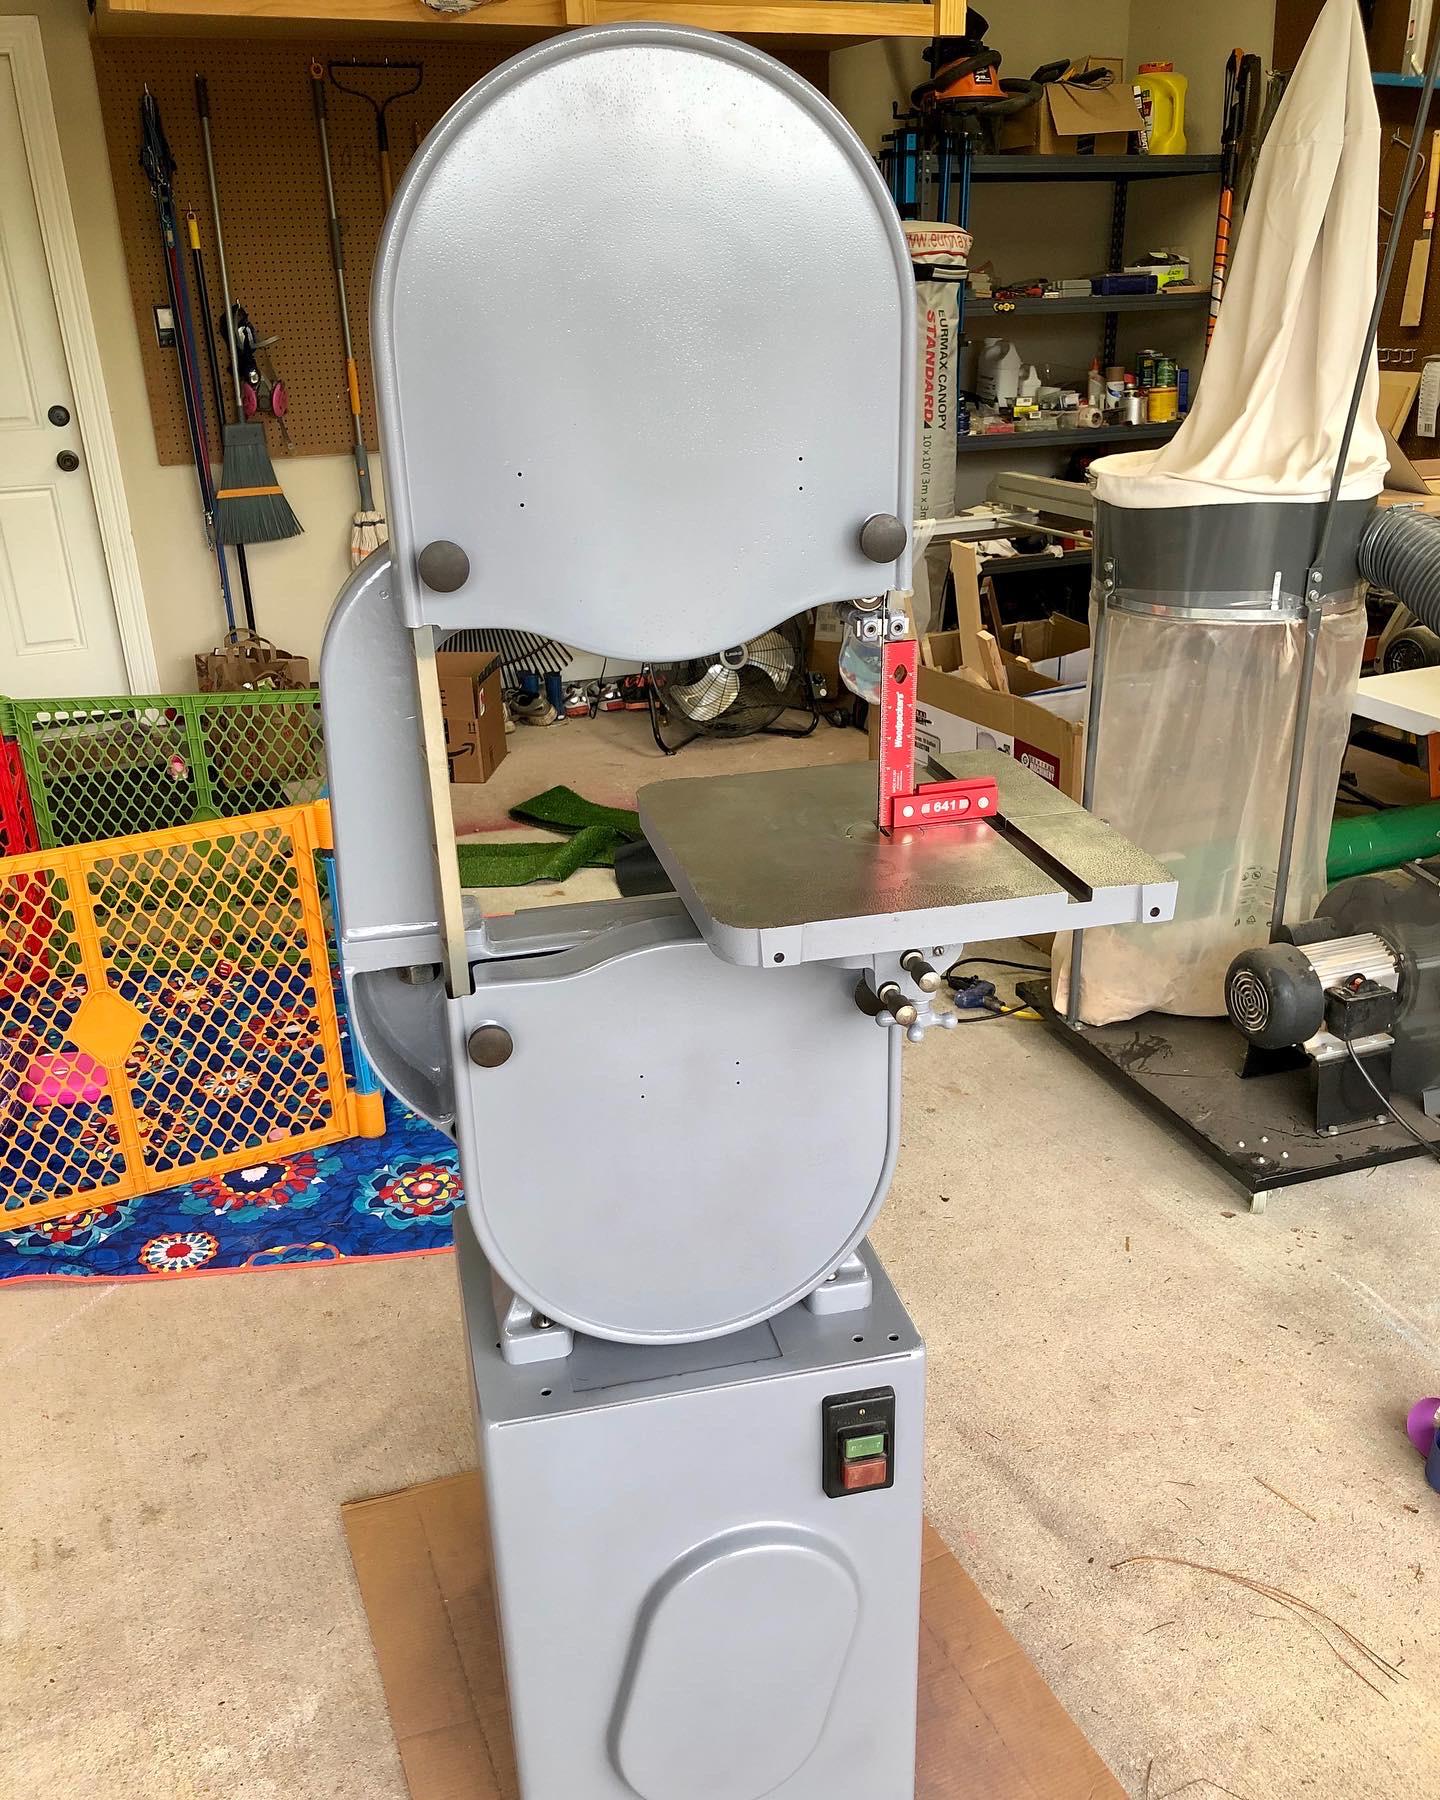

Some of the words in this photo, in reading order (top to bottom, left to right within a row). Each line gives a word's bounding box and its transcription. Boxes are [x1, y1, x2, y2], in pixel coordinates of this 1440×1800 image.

[923, 309, 937, 423] STANDARD
[938, 309, 949, 371] EURMAX
[937, 373, 948, 431] CANOPY
[894, 691, 905, 748] Woodpeckers
[933, 798, 956, 813] 641
